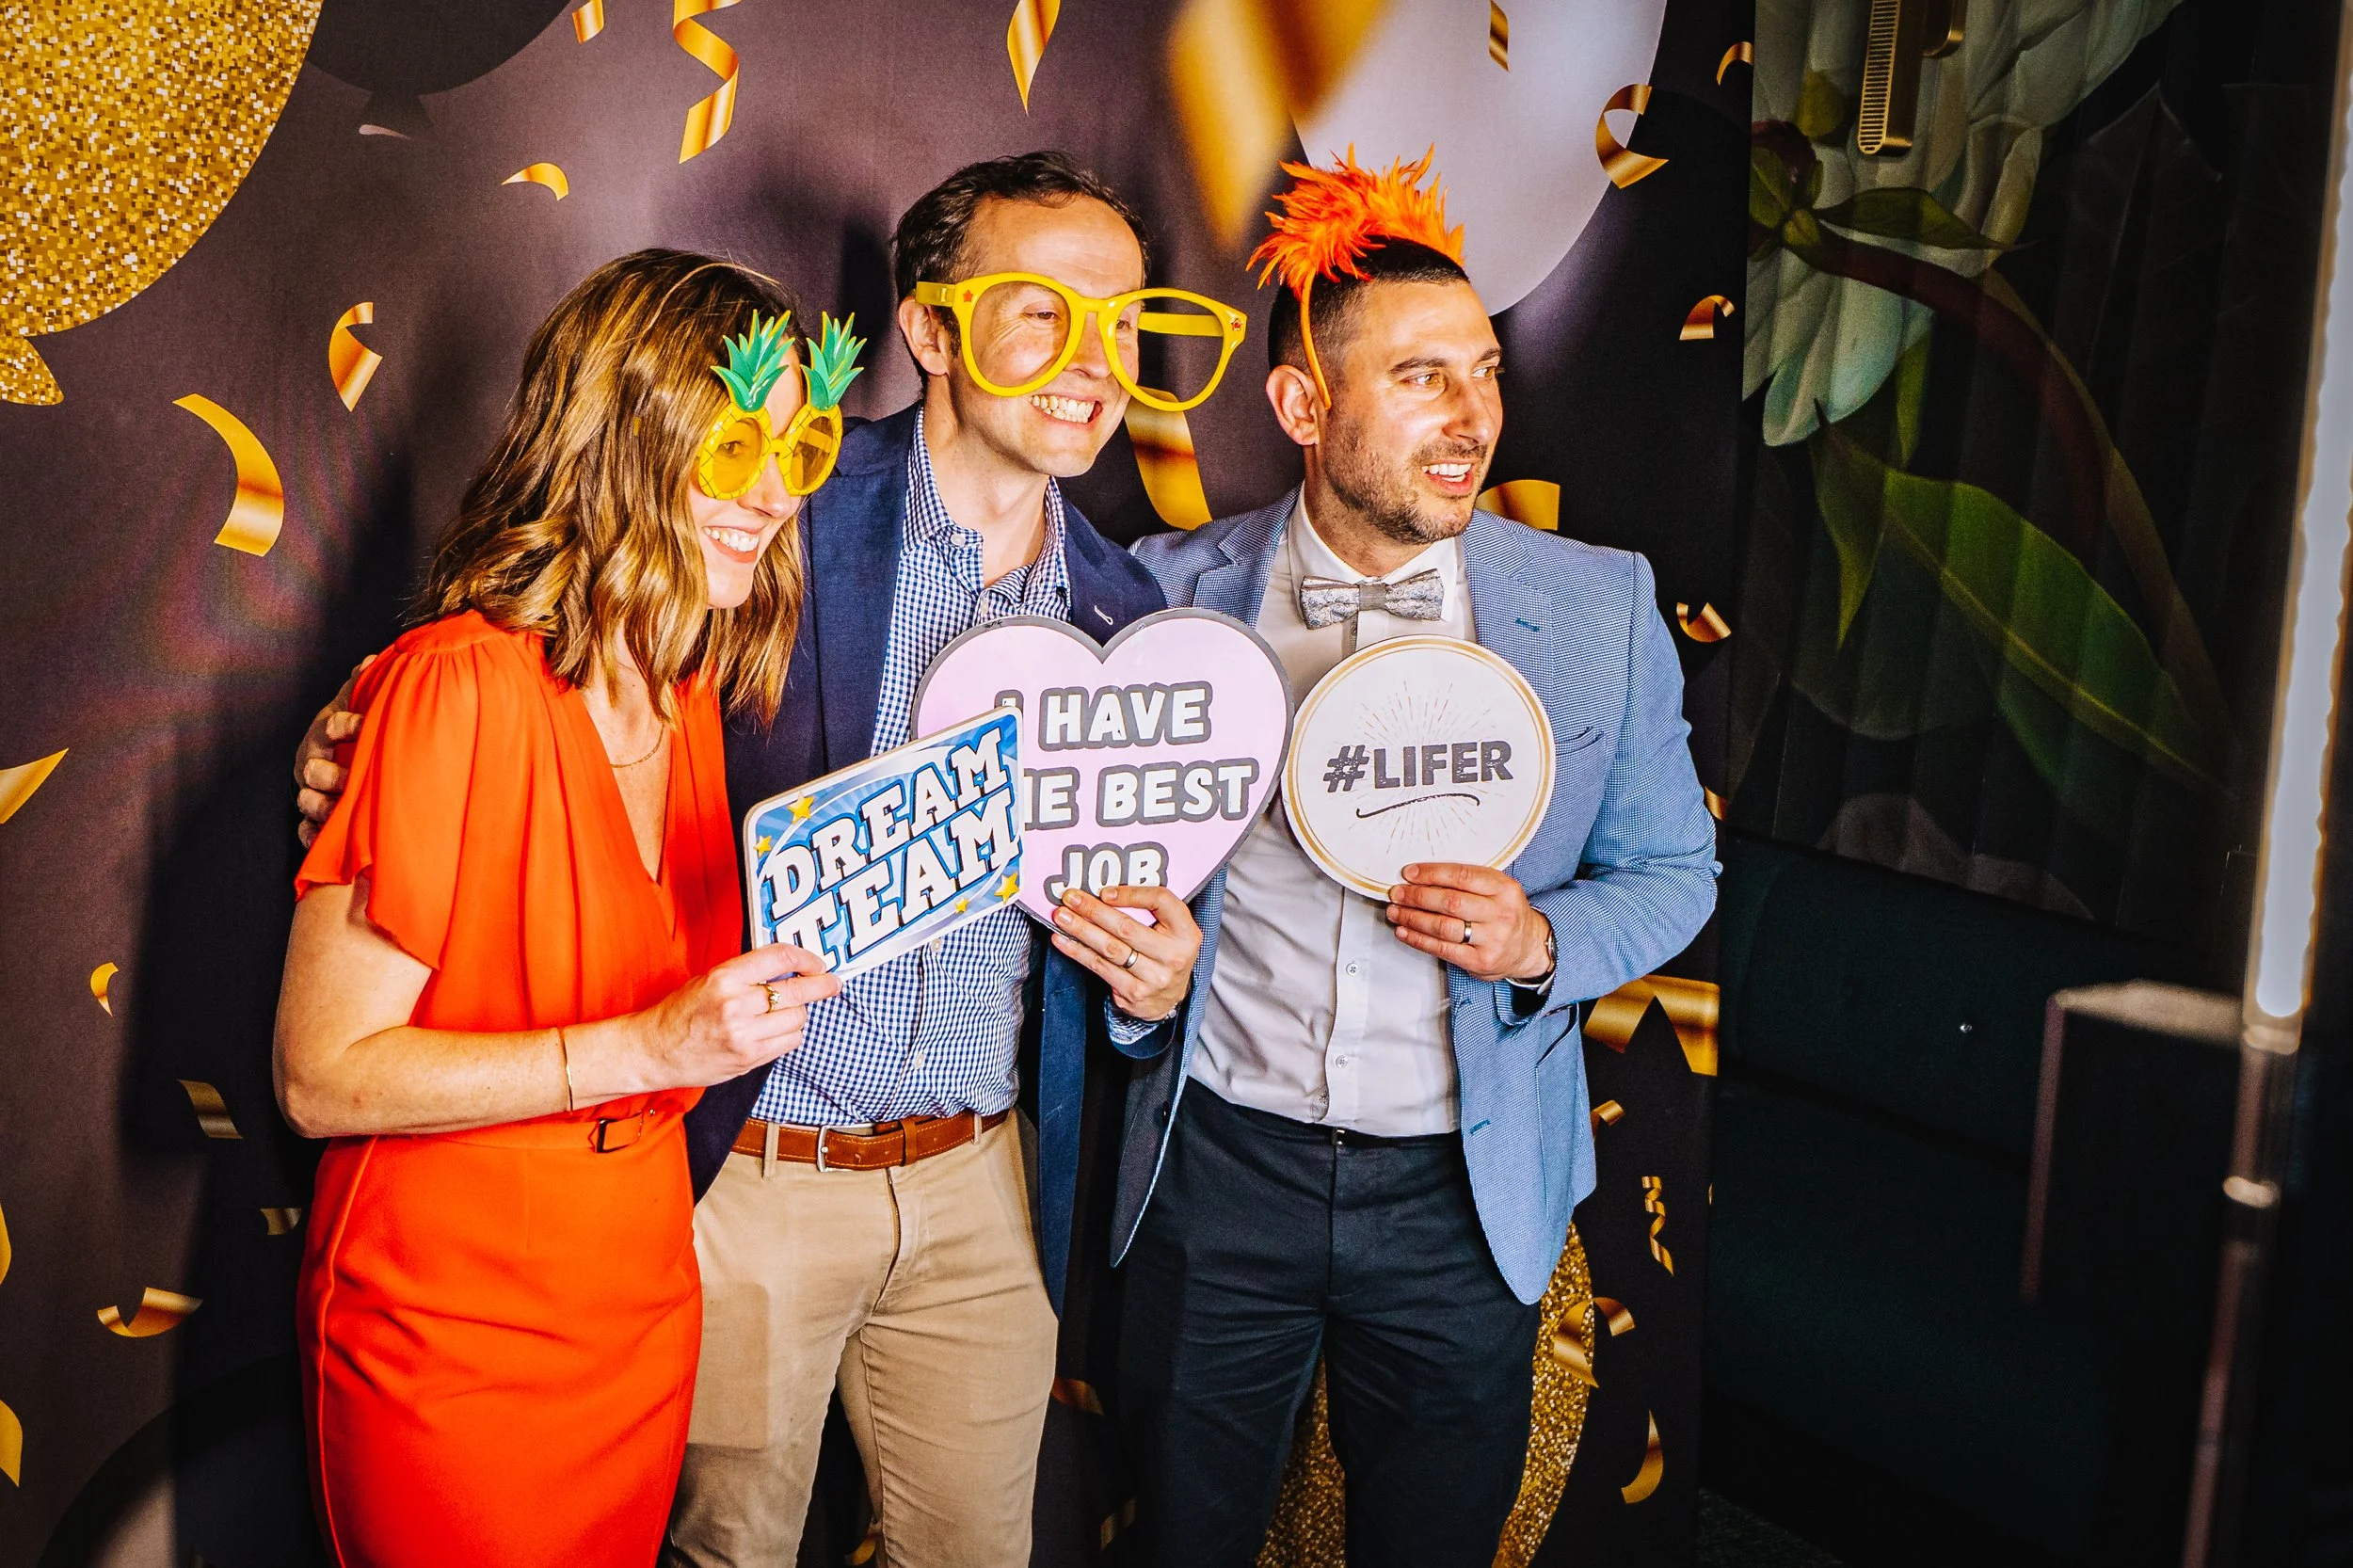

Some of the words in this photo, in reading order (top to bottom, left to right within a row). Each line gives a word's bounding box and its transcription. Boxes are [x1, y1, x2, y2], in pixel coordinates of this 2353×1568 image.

[1044, 688, 1207, 744] HAVE
[1102, 765, 1253, 820] BEST
[1322, 740, 1513, 792] #LIFER
[765, 727, 1008, 919] DREAM
[776, 791, 1020, 971] TEAM
[1050, 847, 1160, 898] JOB
